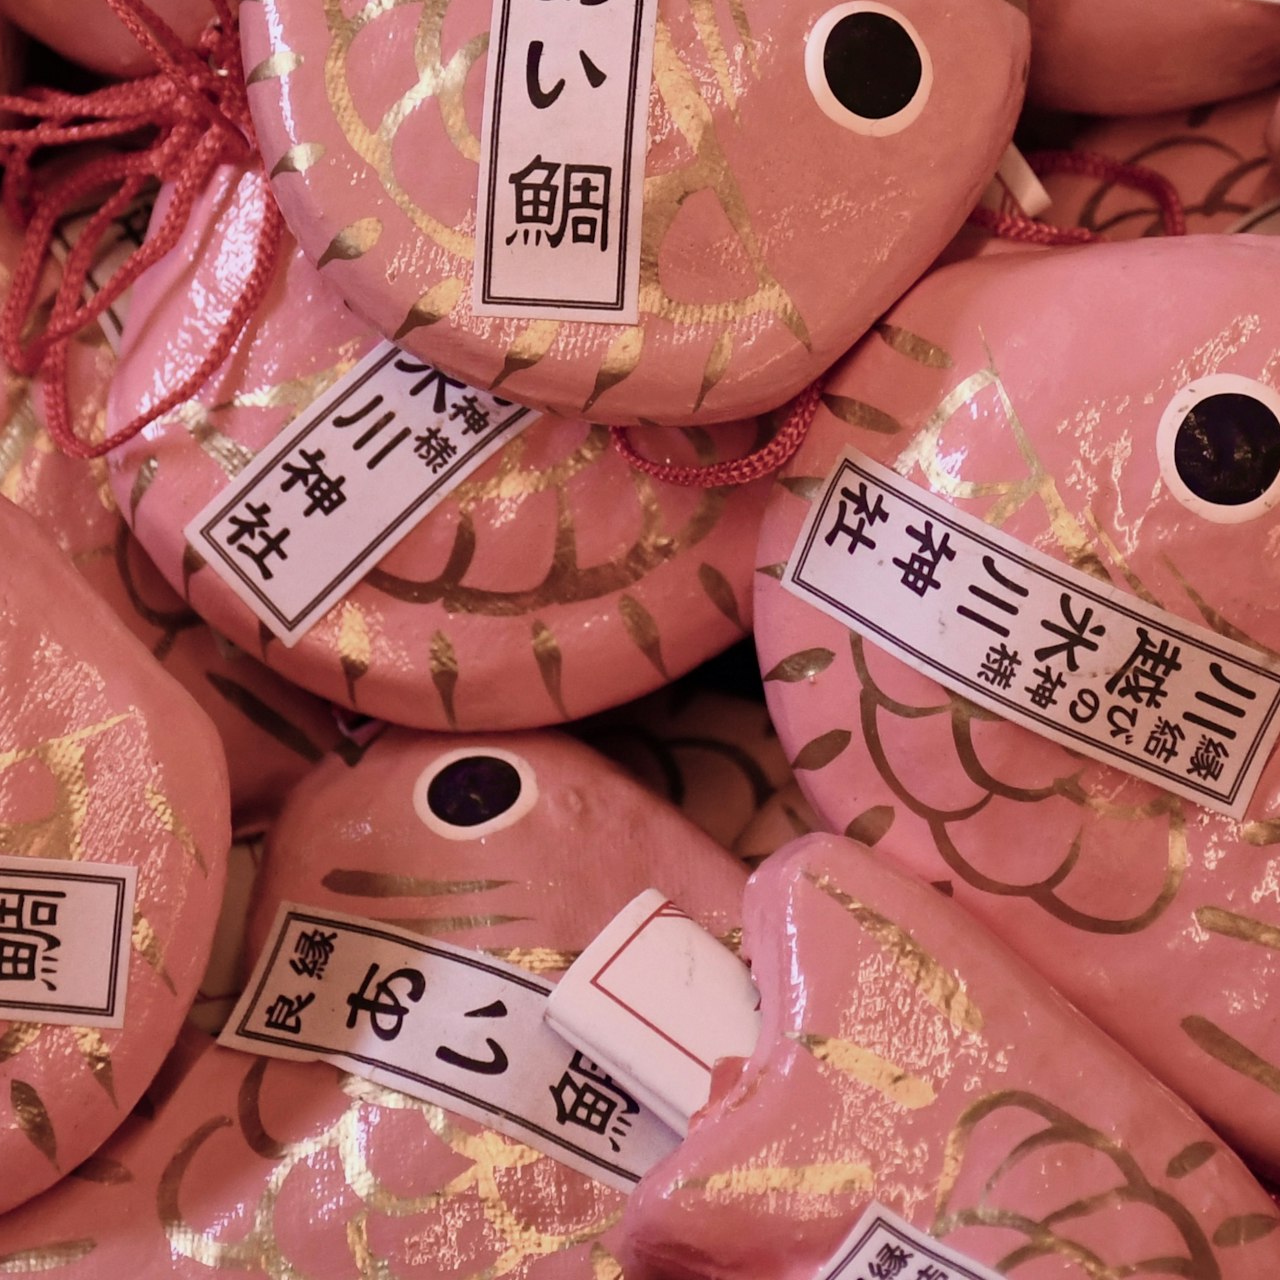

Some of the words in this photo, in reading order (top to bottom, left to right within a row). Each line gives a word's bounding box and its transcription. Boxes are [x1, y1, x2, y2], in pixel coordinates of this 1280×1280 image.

[414, 392, 514, 474] 神様
[825, 481, 1258, 741] 川越氷川神社
[977, 642, 1233, 782] 縁結びの神様
[264, 929, 338, 1034] 良縁
